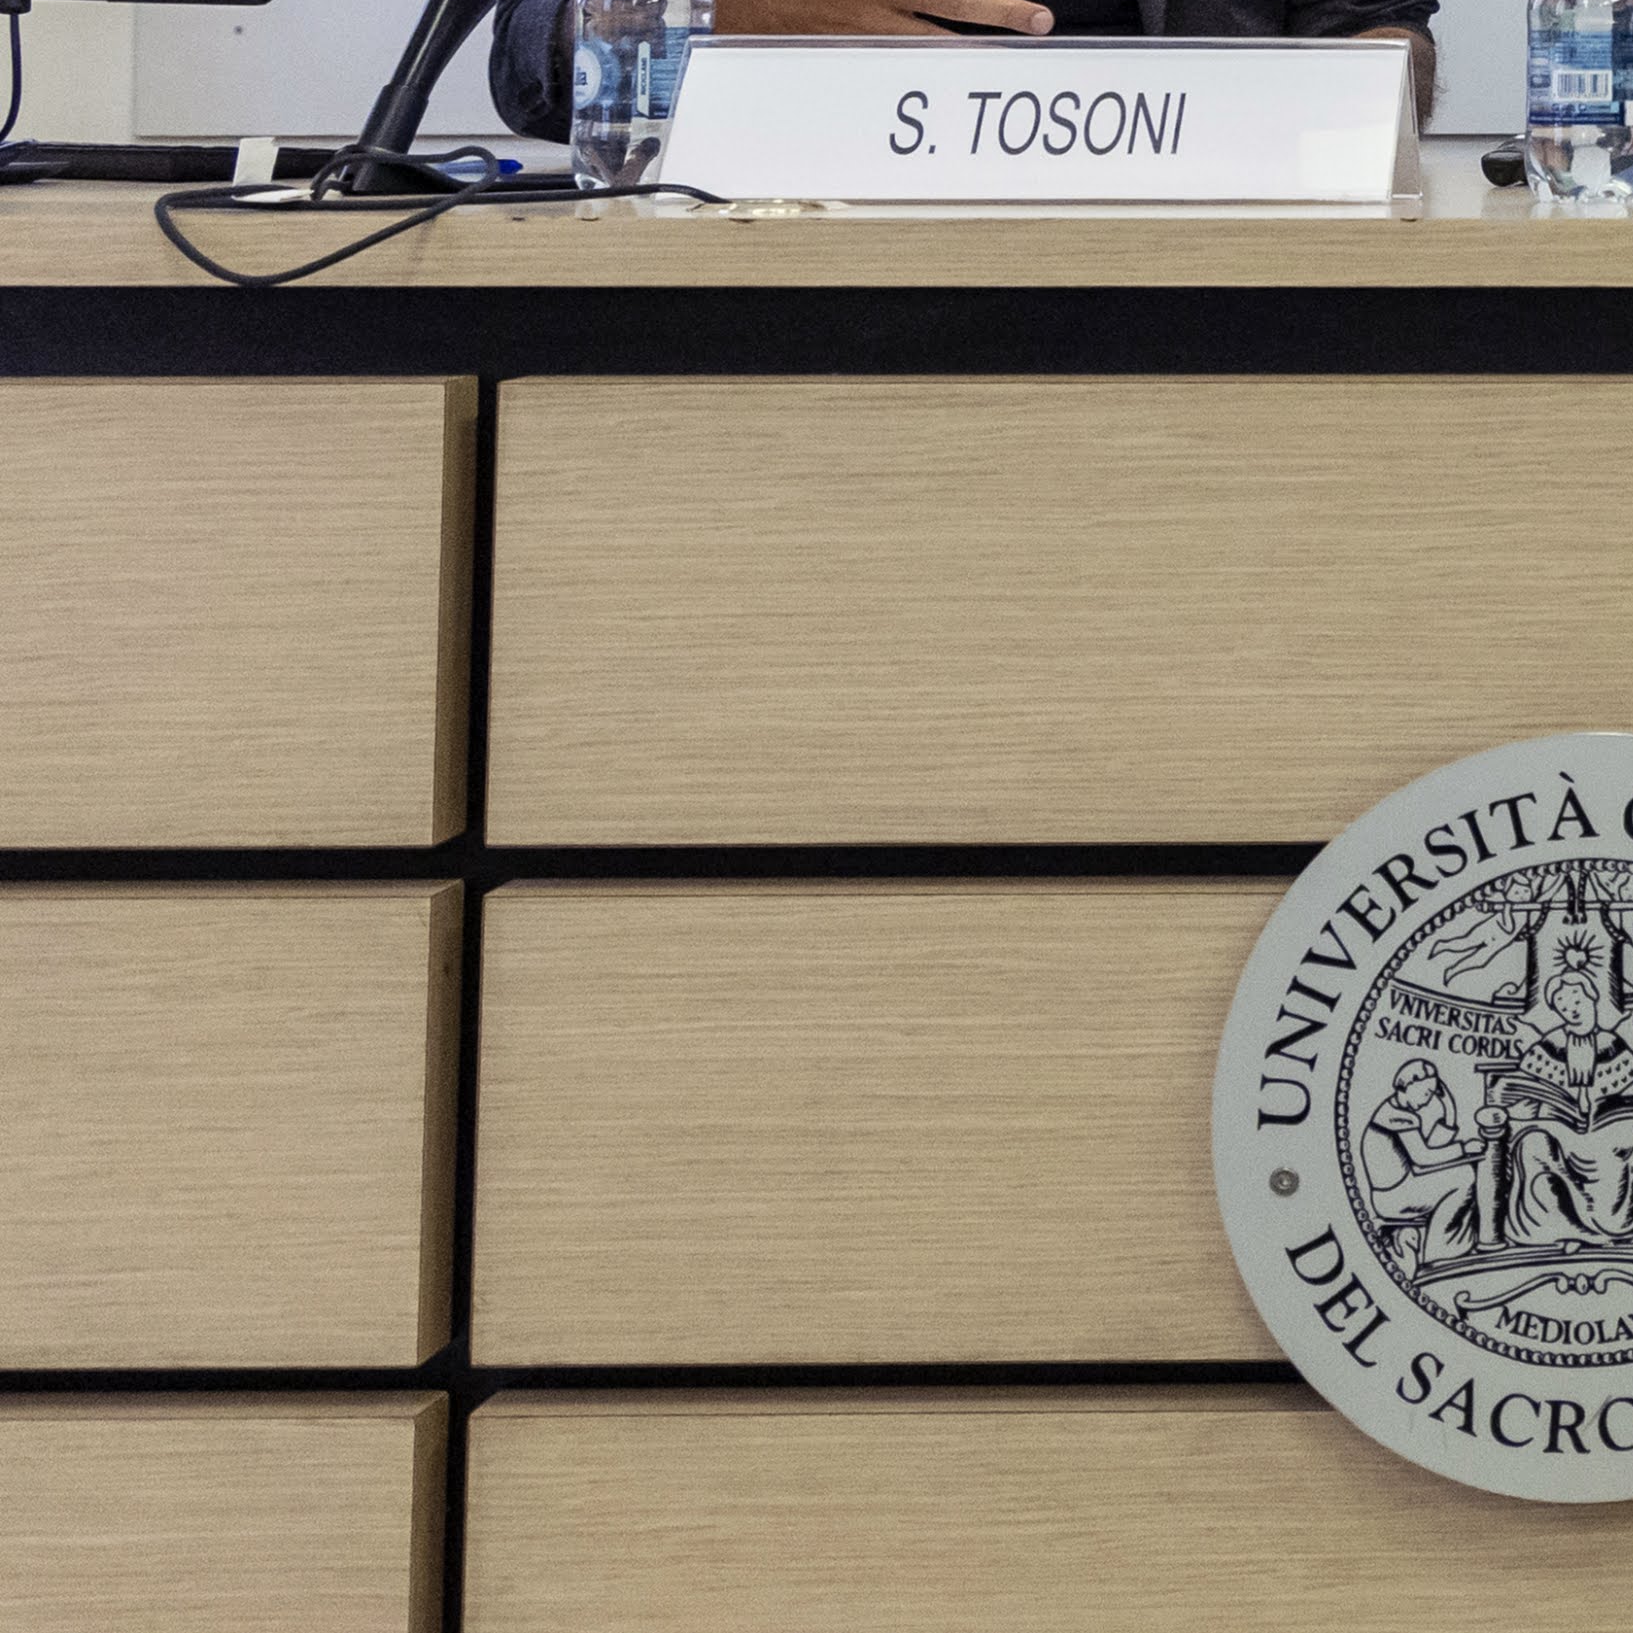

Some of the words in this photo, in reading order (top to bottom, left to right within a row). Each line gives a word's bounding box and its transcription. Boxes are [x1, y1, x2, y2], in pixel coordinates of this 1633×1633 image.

[889, 90, 937, 156] S.
[966, 90, 1188, 156] TOSONI
[1257, 772, 1600, 1130] UNIVERSITÀ
[1374, 1016, 1443, 1050] SACRI
[1285, 1224, 1392, 1368] DEL
